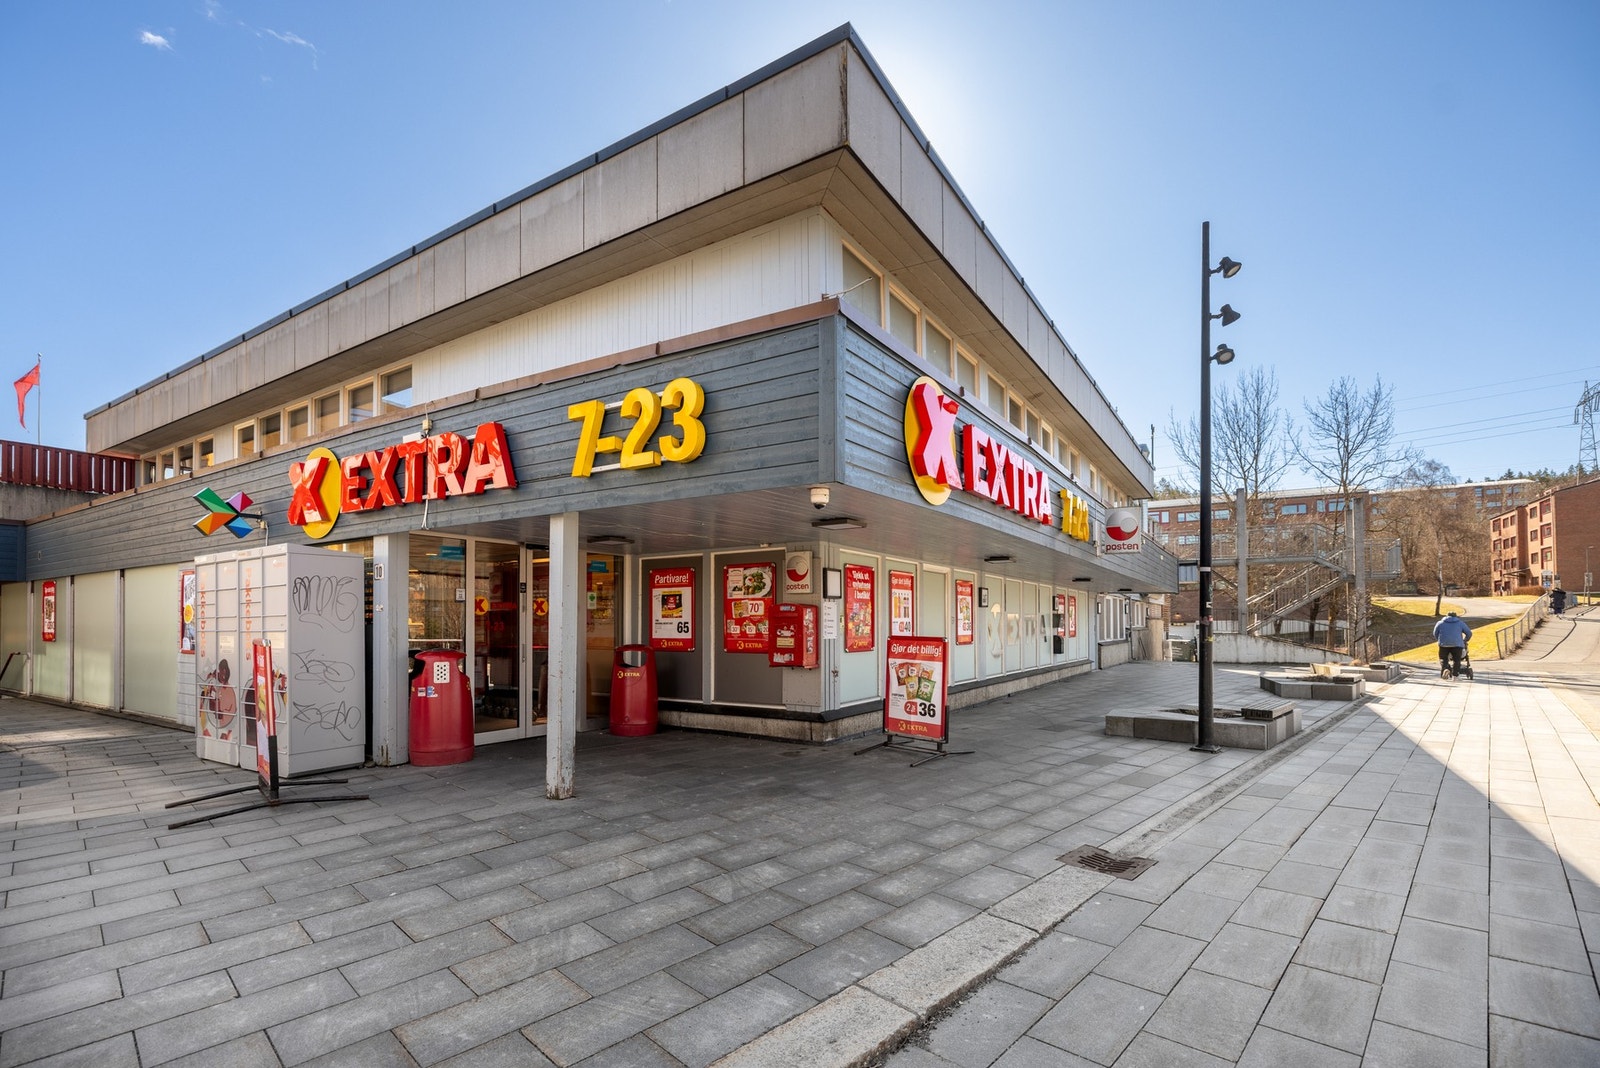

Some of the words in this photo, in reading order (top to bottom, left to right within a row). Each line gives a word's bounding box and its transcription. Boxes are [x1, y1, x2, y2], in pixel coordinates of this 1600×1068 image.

[568, 377, 706, 477] 7-23
[340, 422, 517, 514] EXTRA
[963, 424, 1053, 526] EXTRA
[1105, 542, 1139, 552] posten
[654, 573, 689, 584] Partivare!
[786, 583, 810, 591] posten
[749, 603, 760, 613] 70
[677, 621, 689, 633] 65
[891, 643, 906, 655] Gjør
[907, 644, 920, 654] det
[920, 645, 942, 657] billig!
[918, 702, 937, 718] 36
[907, 724, 927, 732] EXTRA
